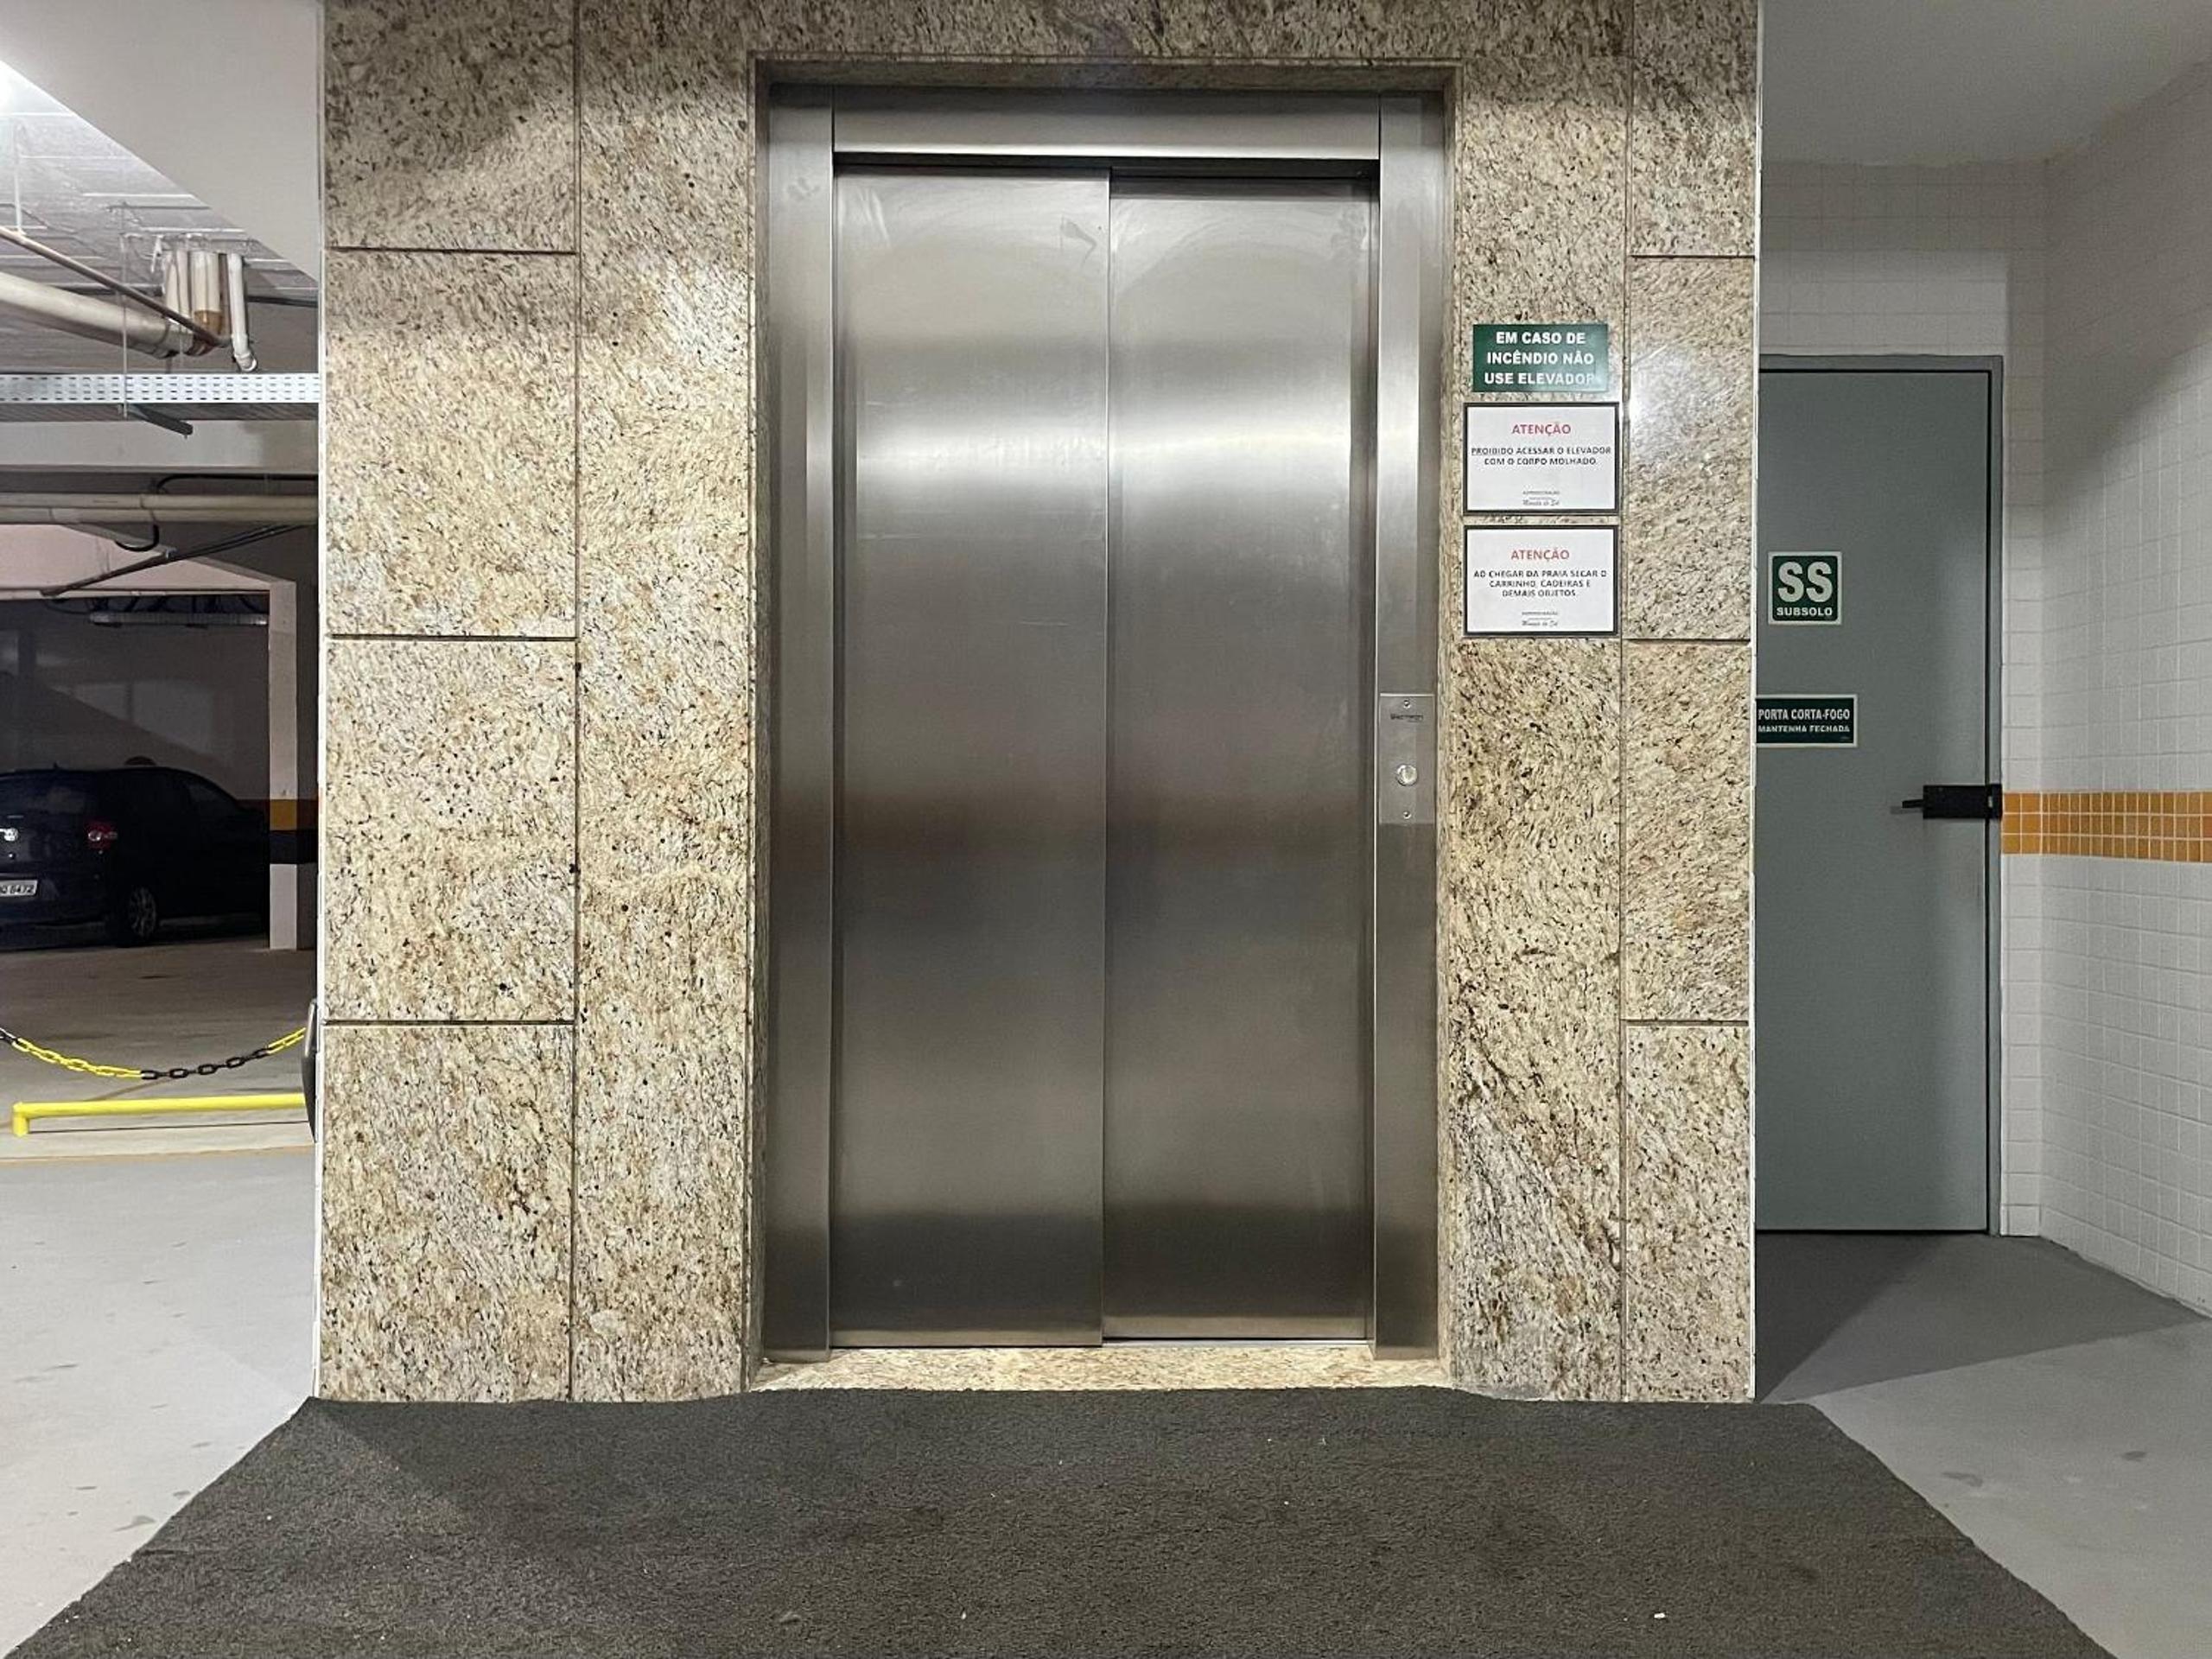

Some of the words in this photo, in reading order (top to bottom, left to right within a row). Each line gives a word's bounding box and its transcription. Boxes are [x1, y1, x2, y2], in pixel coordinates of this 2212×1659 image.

[1496, 332, 1516, 344] EM
[1522, 332, 1561, 344] CASO
[1567, 332, 1586, 344] DE
[1487, 350, 1557, 364] INCÊNDIO
[1563, 350, 1594, 365] NÃO
[1484, 372, 1513, 384] USE
[1518, 372, 1595, 385] ELEVADOR
[1512, 422, 1571, 436] ATENÇÃO
[1510, 547, 1570, 562] ATENÇÃO
[1777, 562, 1833, 602] SS
[1777, 607, 1833, 616] SUBSOLO
[1758, 709, 1789, 720] PORTA
[1791, 709, 1851, 720] CORTA-FOGO
